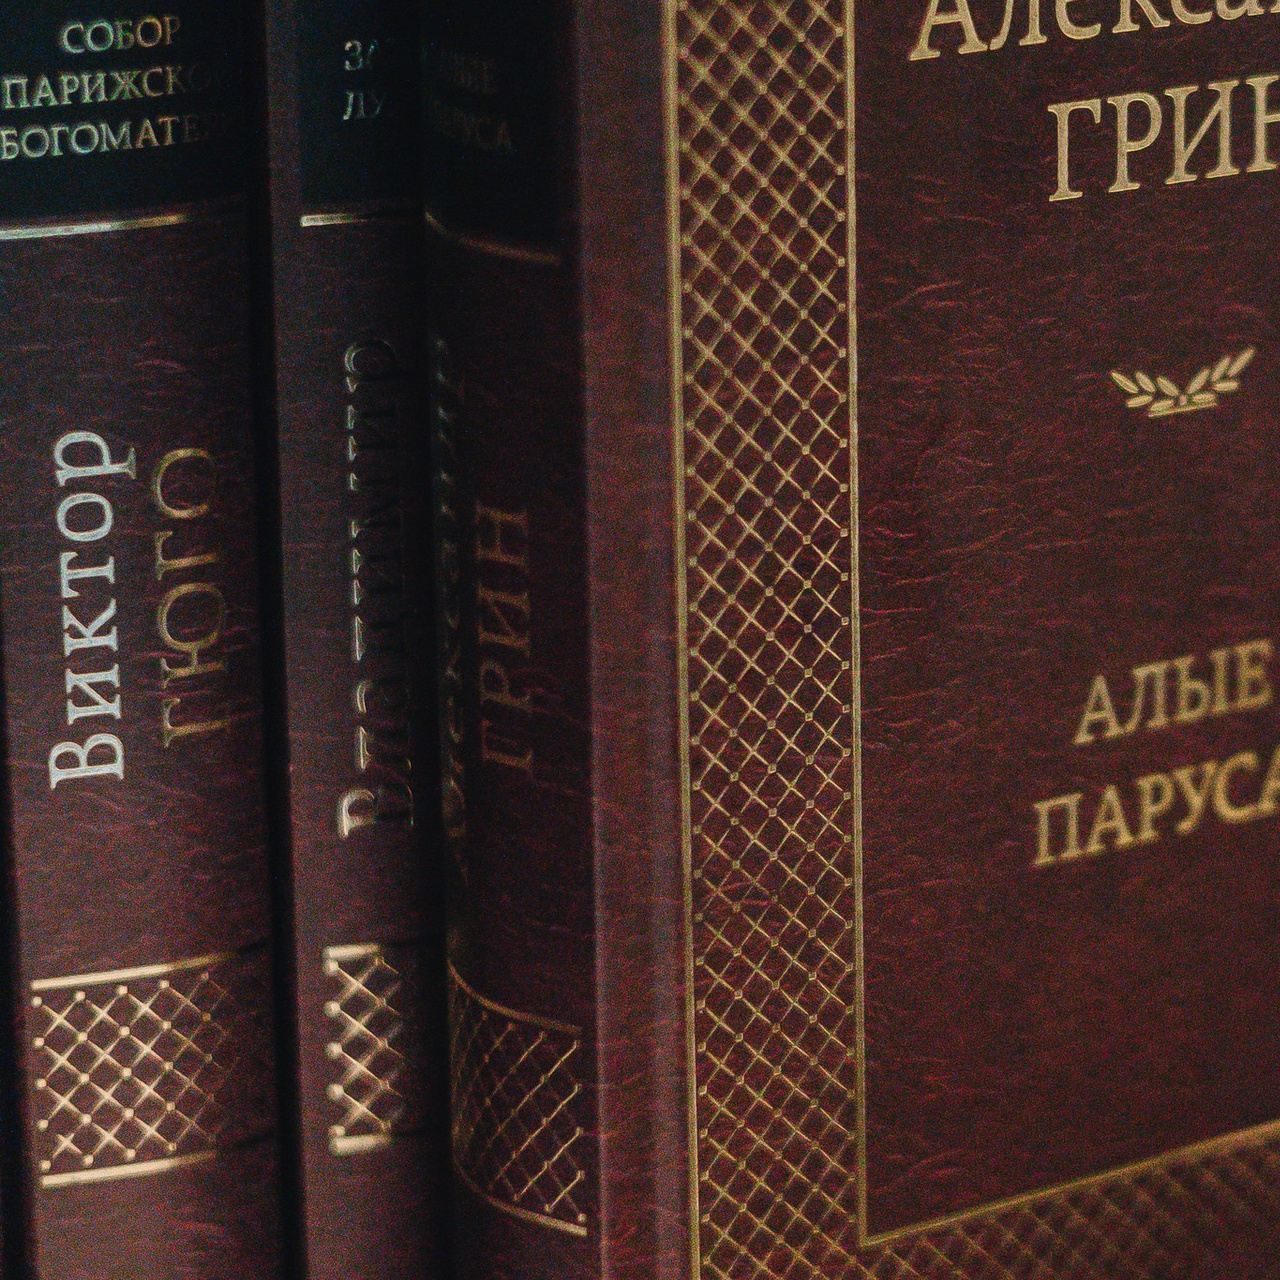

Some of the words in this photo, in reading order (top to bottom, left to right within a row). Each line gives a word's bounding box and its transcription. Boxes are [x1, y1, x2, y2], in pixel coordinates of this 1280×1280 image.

[1, 62, 212, 110] ПАРИЖСКО
[60, 14, 181, 55] СОБОР
[0, 113, 202, 162] БОГОМАТЕ
[49, 428, 137, 790] Виктор
[151, 446, 231, 748] ГЮГО
[476, 501, 535, 780] ГРИН
[1072, 637, 1275, 745] АЛЫЕ
